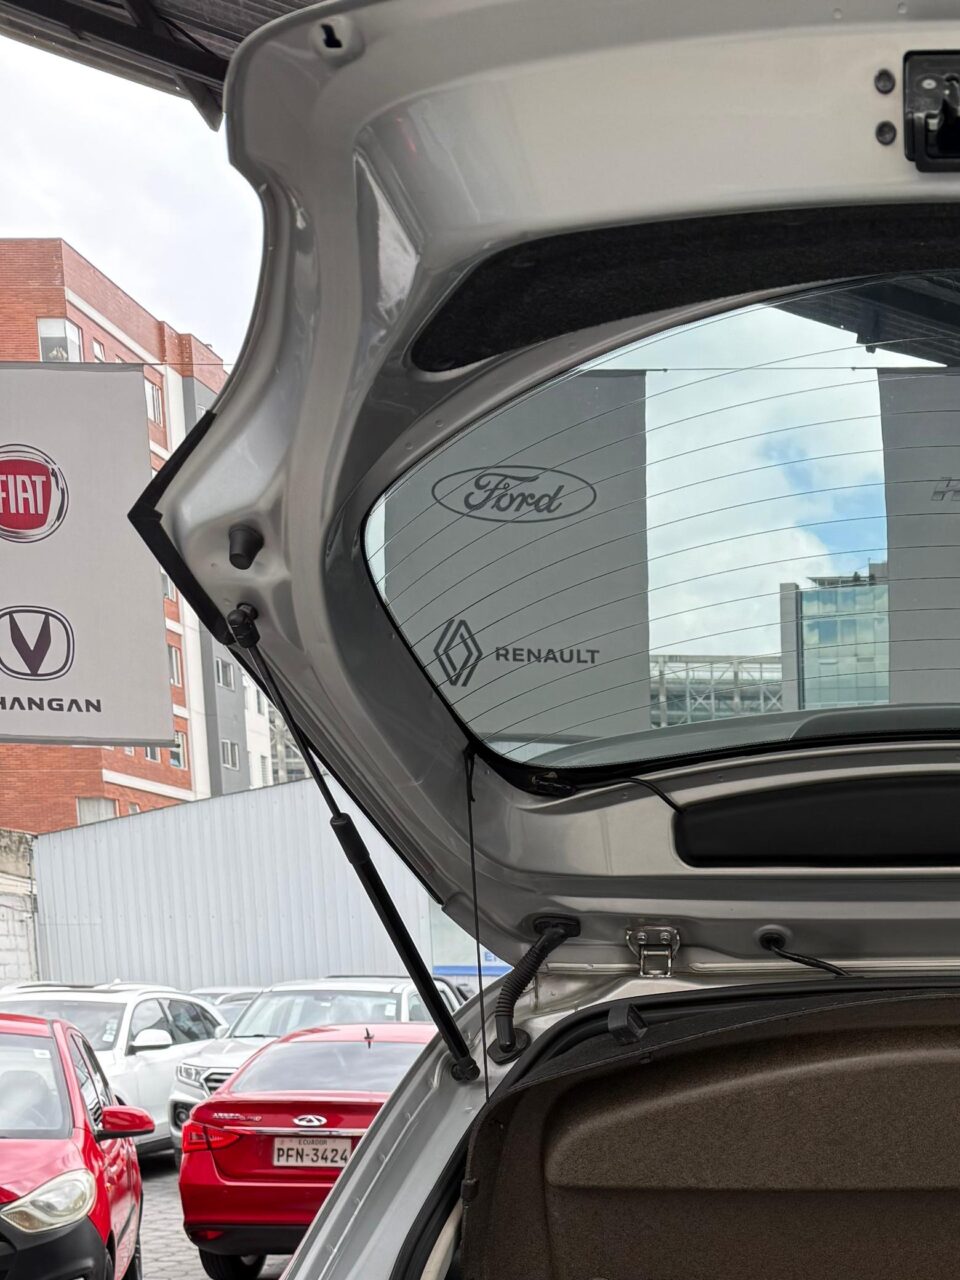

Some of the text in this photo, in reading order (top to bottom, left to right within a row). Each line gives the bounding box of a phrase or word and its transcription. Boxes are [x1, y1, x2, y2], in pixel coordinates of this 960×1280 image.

[463, 472, 565, 513] Ford
[495, 646, 600, 664] RENAULT
[276, 1147, 348, 1163] PFN-3424
